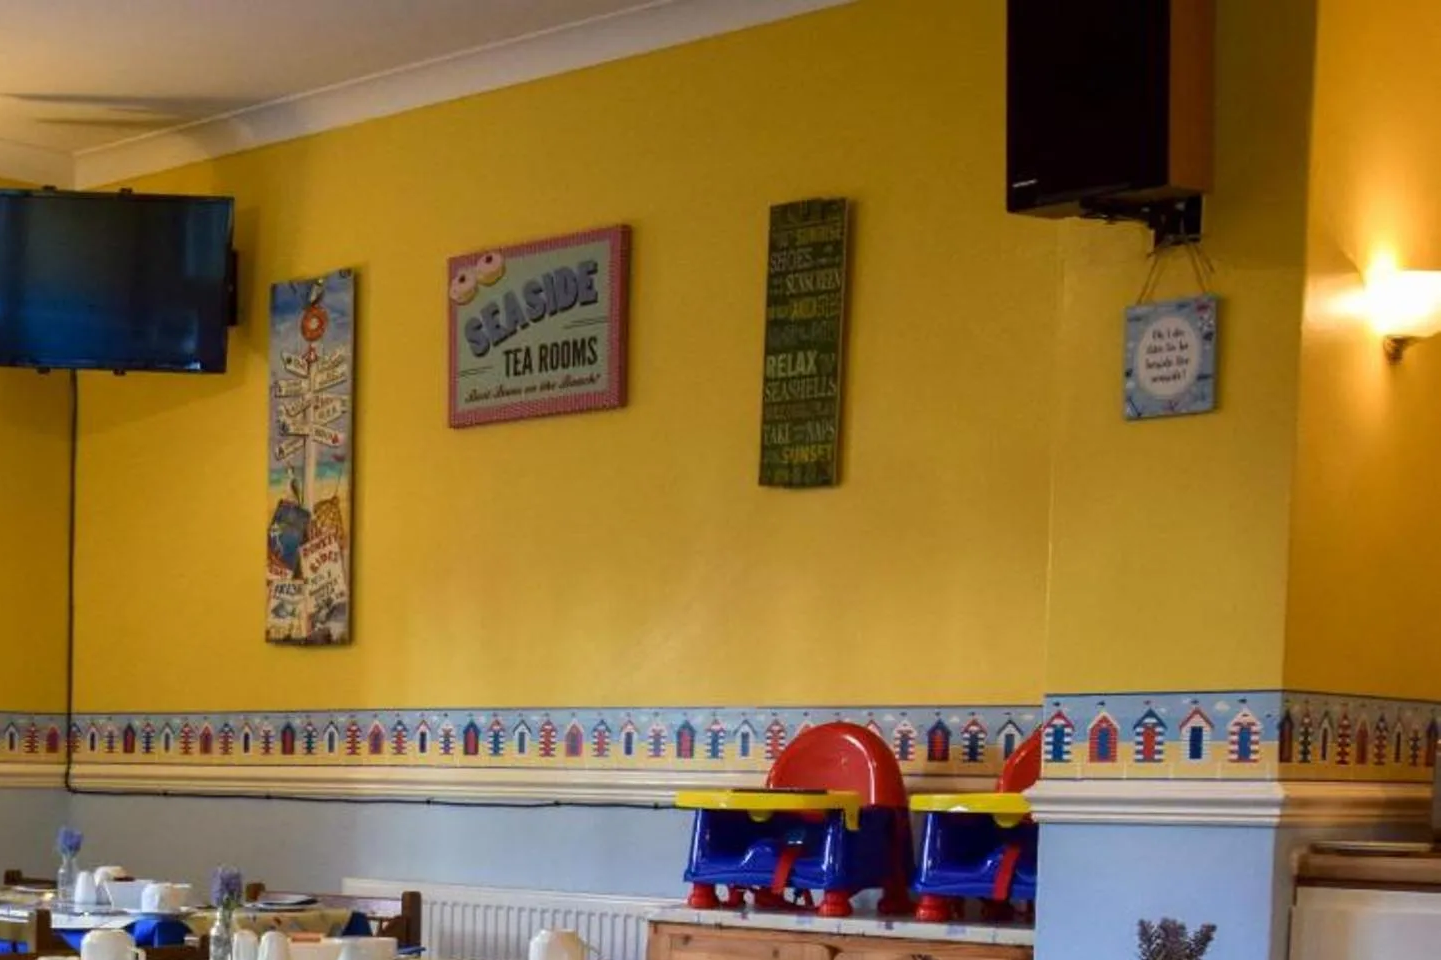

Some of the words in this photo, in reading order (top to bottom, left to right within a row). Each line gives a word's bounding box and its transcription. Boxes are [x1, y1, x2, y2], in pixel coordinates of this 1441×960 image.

[464, 259, 599, 359] SEASIDE
[503, 345, 534, 379] TEA
[538, 336, 599, 373] ROOMS
[765, 350, 818, 379] RELAX
